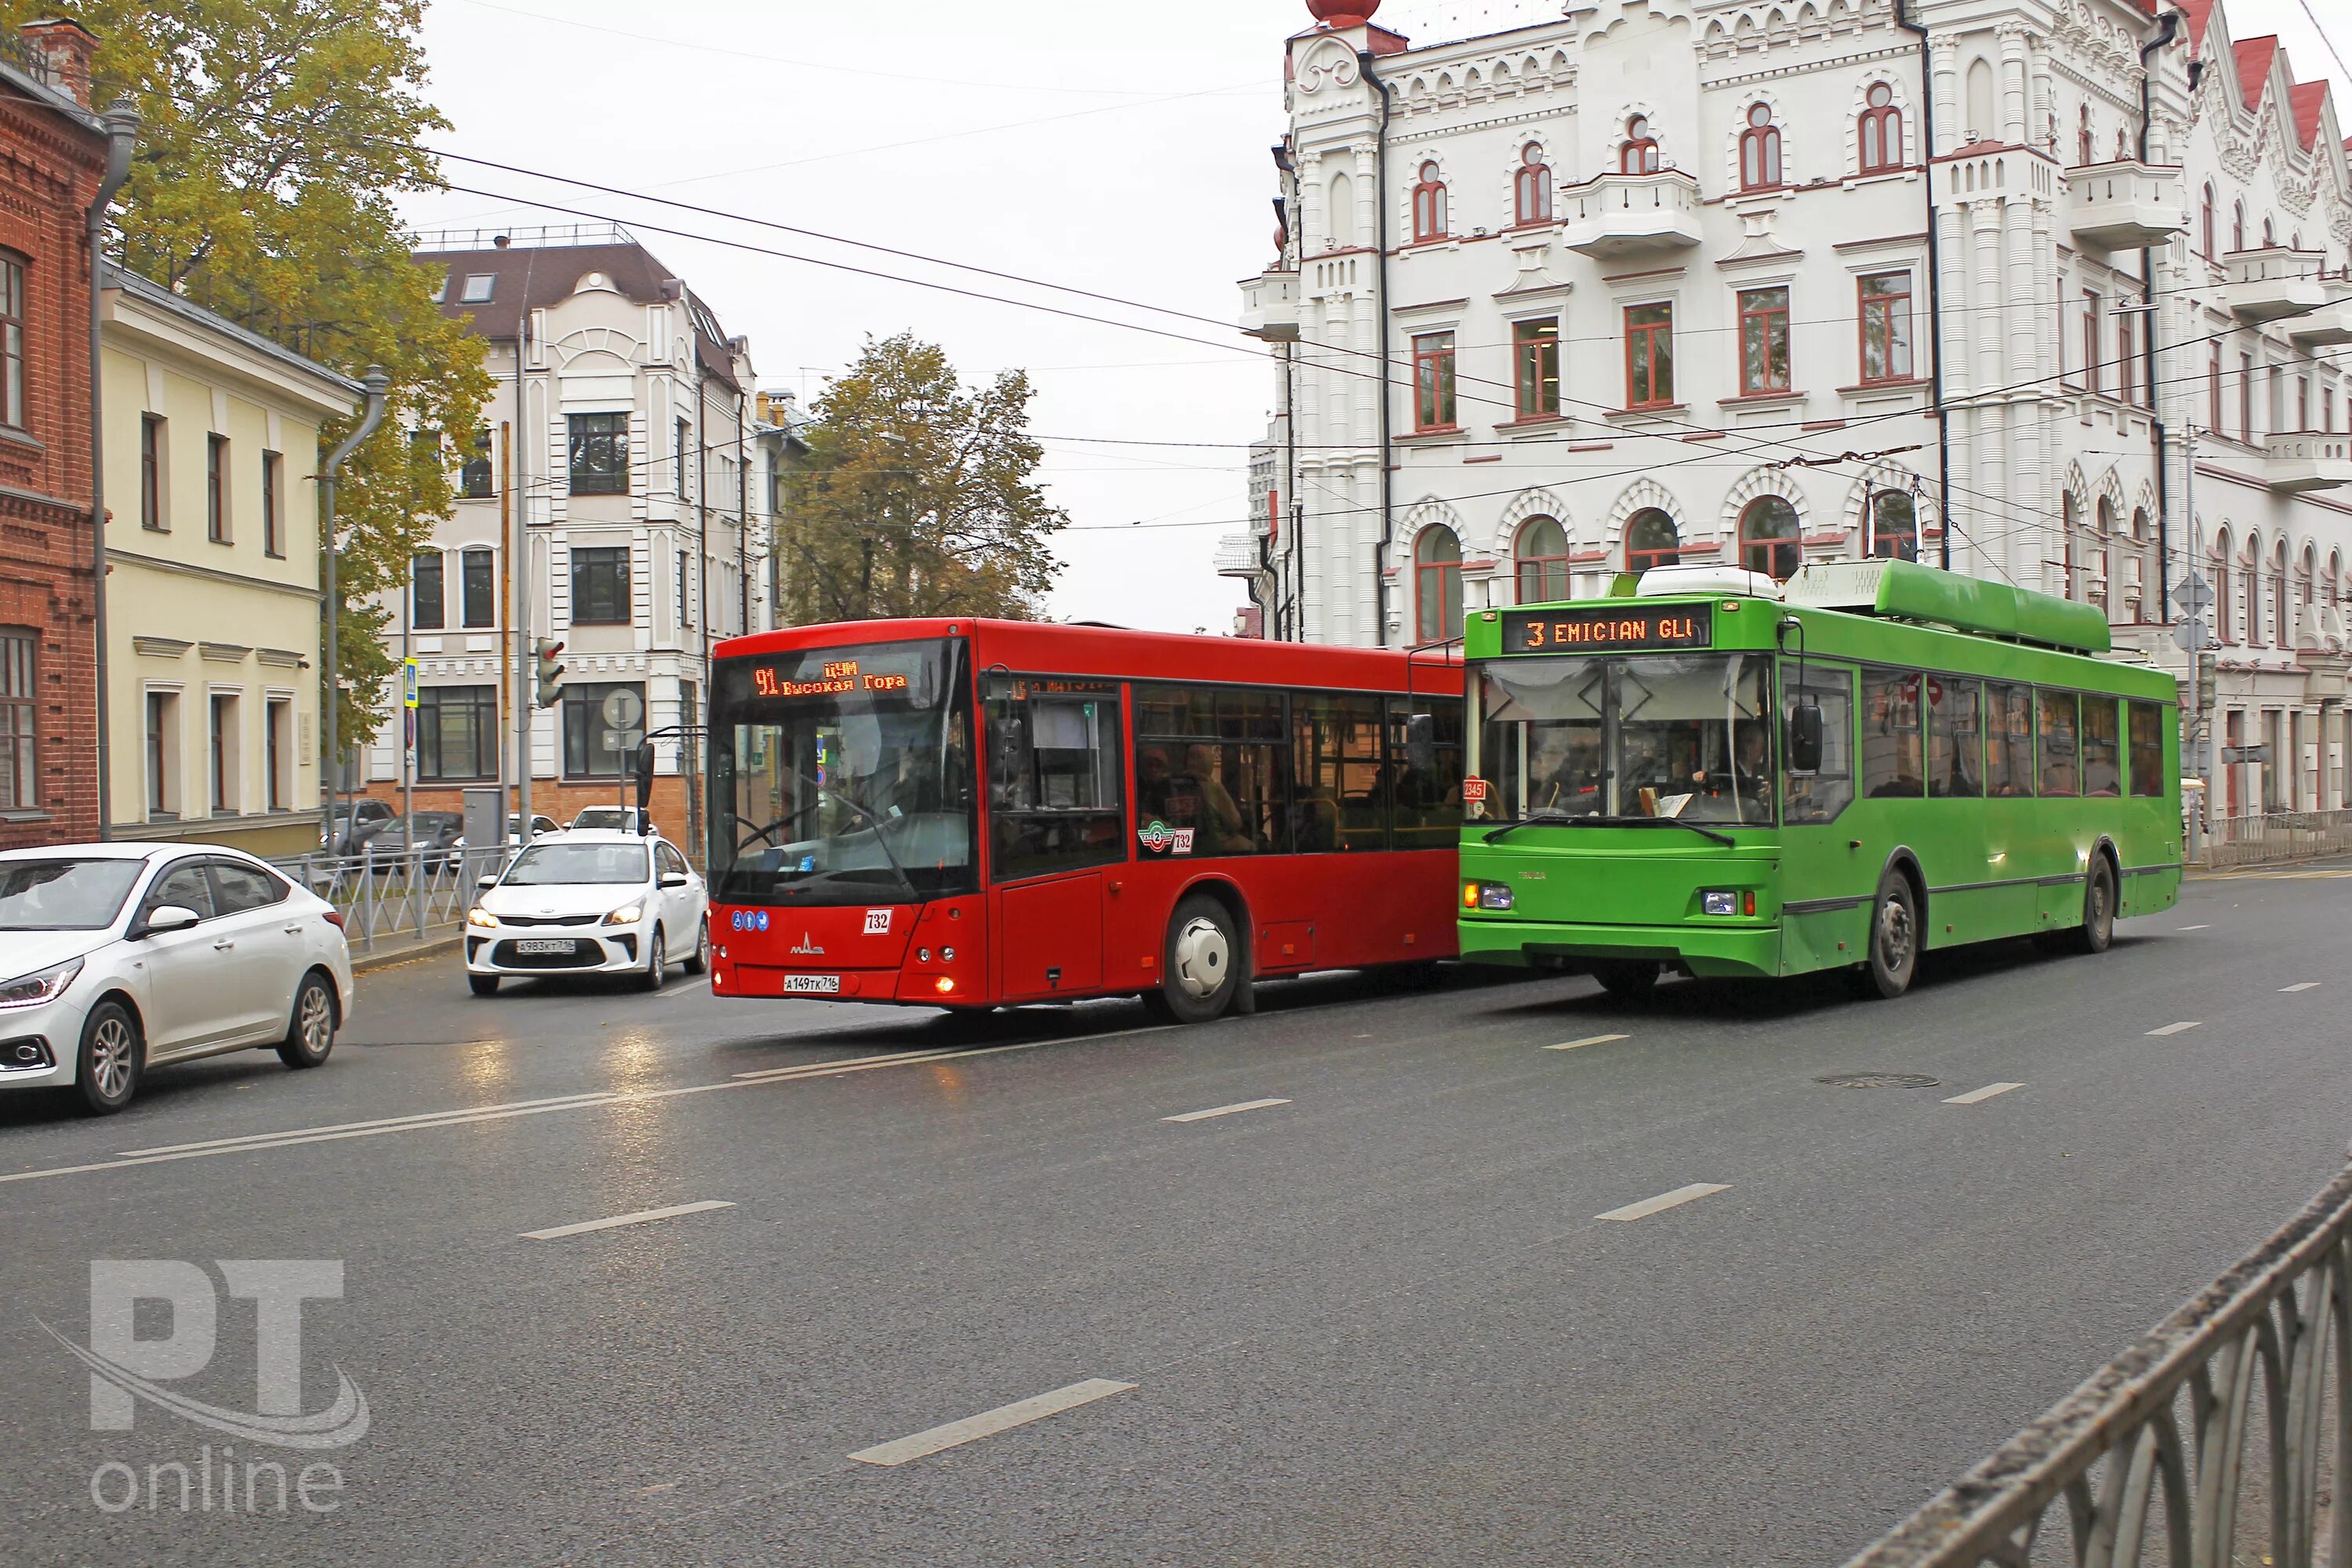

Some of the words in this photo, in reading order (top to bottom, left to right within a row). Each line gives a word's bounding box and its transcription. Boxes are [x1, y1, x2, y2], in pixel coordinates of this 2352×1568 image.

[1526, 622, 1544, 647] 3
[1555, 620, 1646, 643] EMICIAN
[824, 661, 858, 678] ЦУМ
[755, 668, 779, 695] 91
[782, 680, 854, 695] Высокая
[862, 674, 906, 689] Гора
[1465, 783, 1483, 796] 2345
[1175, 834, 1190, 848] 732
[867, 913, 887, 929] 732
